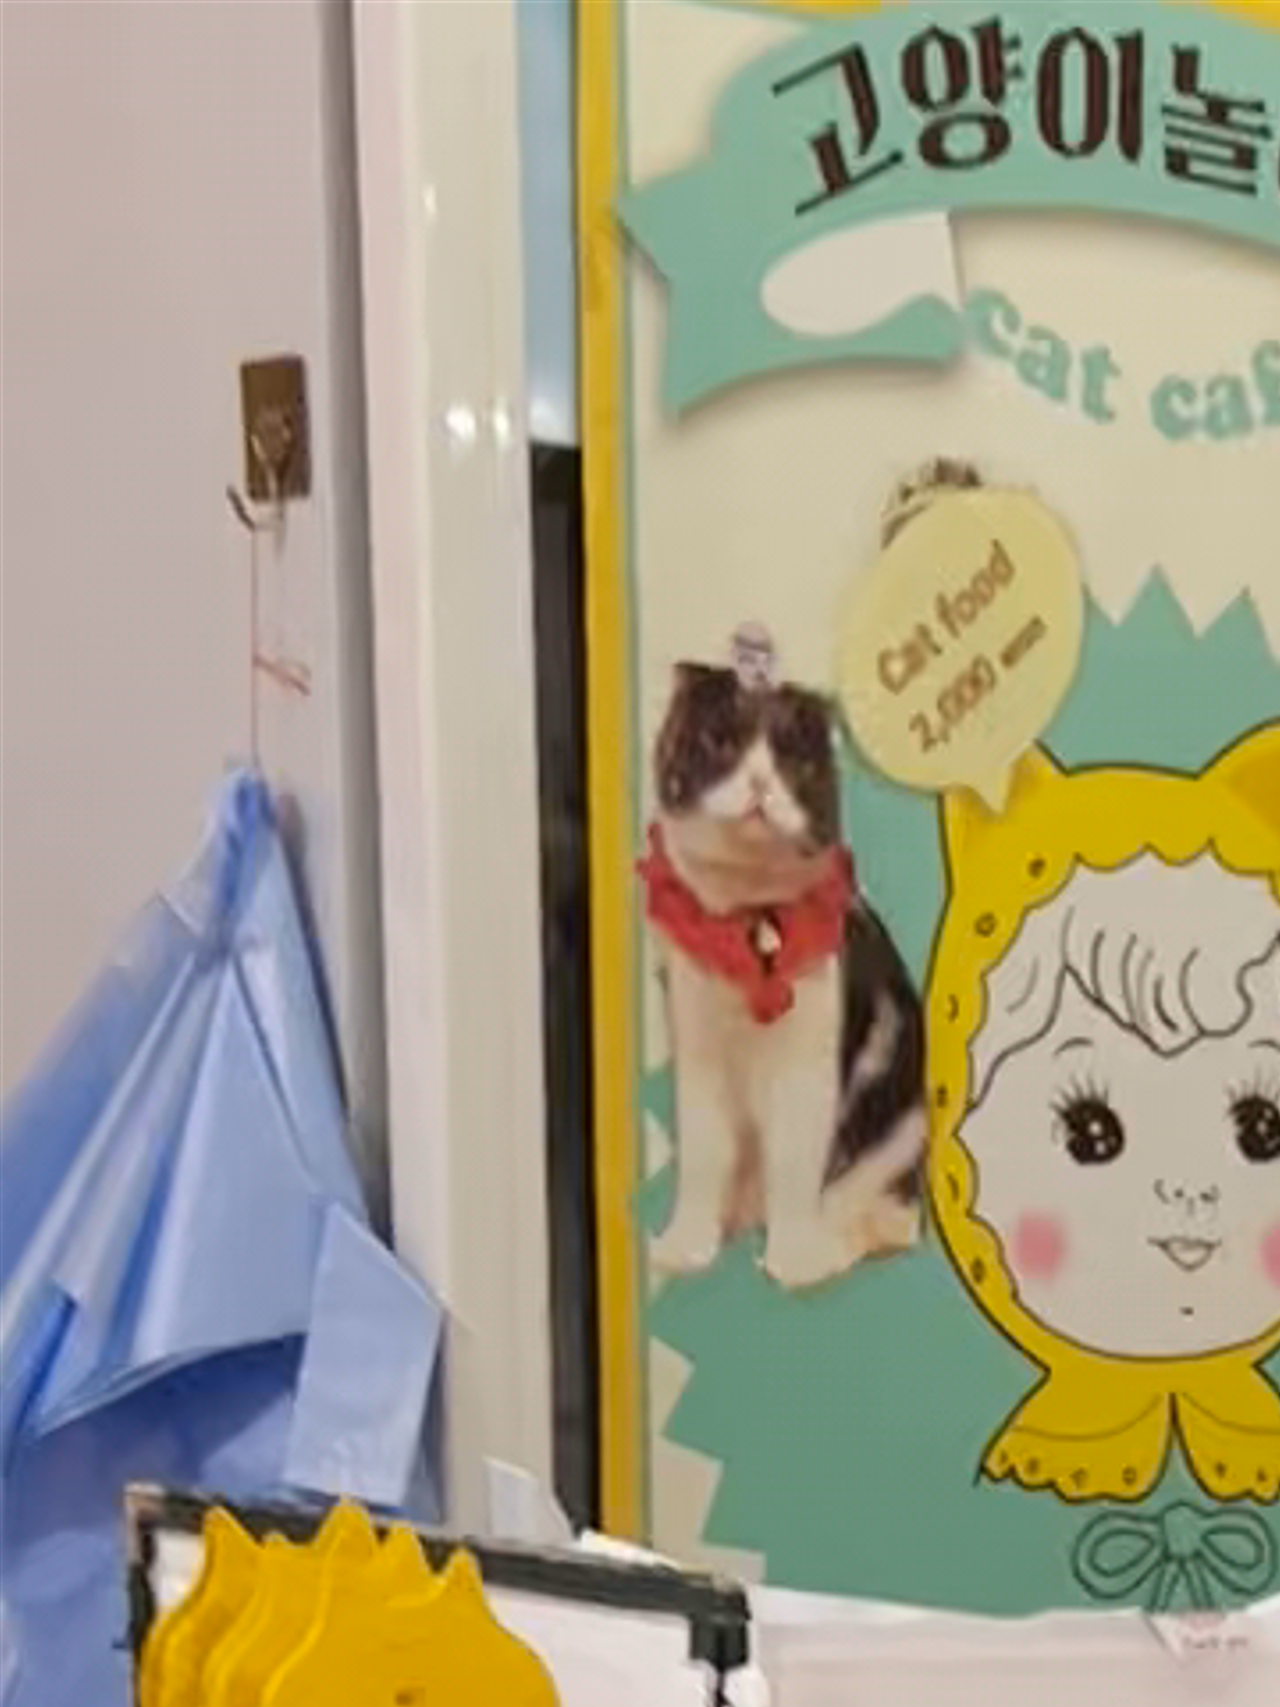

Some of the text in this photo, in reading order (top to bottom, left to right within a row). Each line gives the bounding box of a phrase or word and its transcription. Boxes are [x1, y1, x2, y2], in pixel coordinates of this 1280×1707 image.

[963, 288, 1122, 424] cat
[878, 538, 1015, 694] Cat food
[909, 655, 996, 754] 2,000
